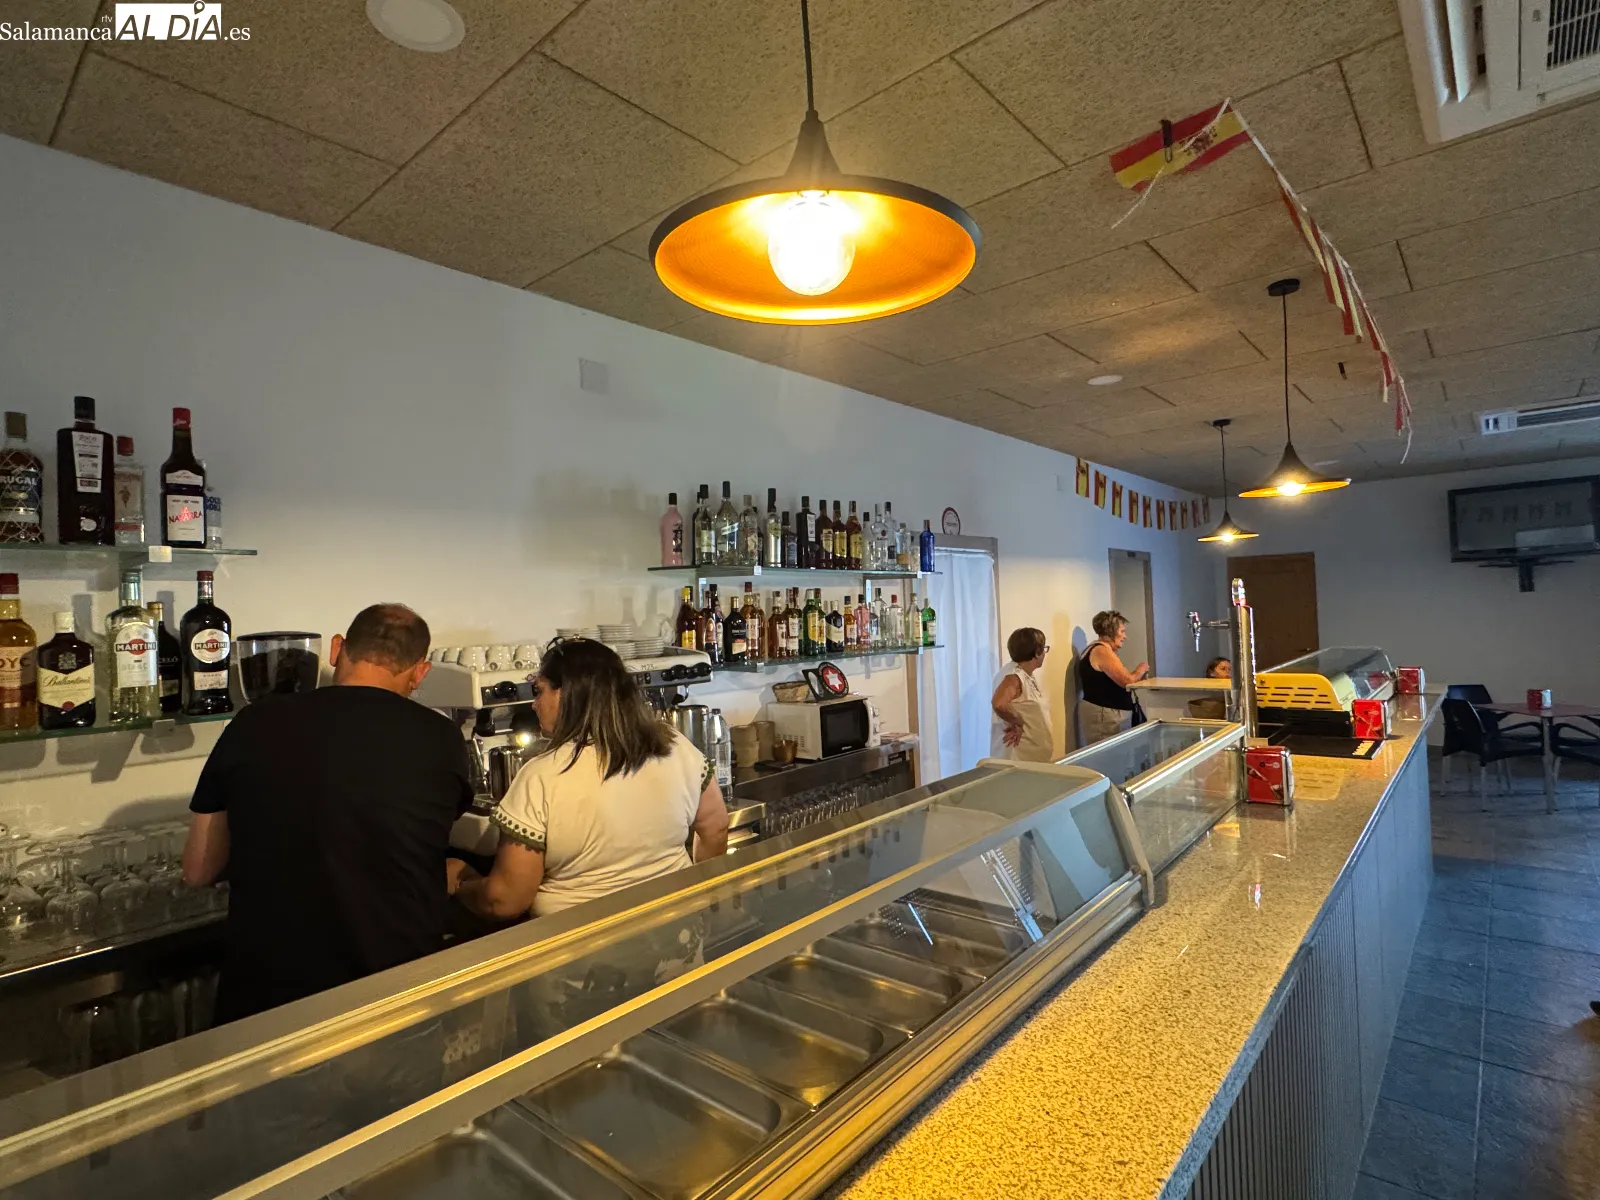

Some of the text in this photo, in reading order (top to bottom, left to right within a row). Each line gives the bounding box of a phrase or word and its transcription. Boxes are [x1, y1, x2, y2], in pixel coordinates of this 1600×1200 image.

[0, 475, 37, 486] RUGAL
[116, 642, 156, 653] MARTINI
[195, 642, 227, 651] MARTINI
